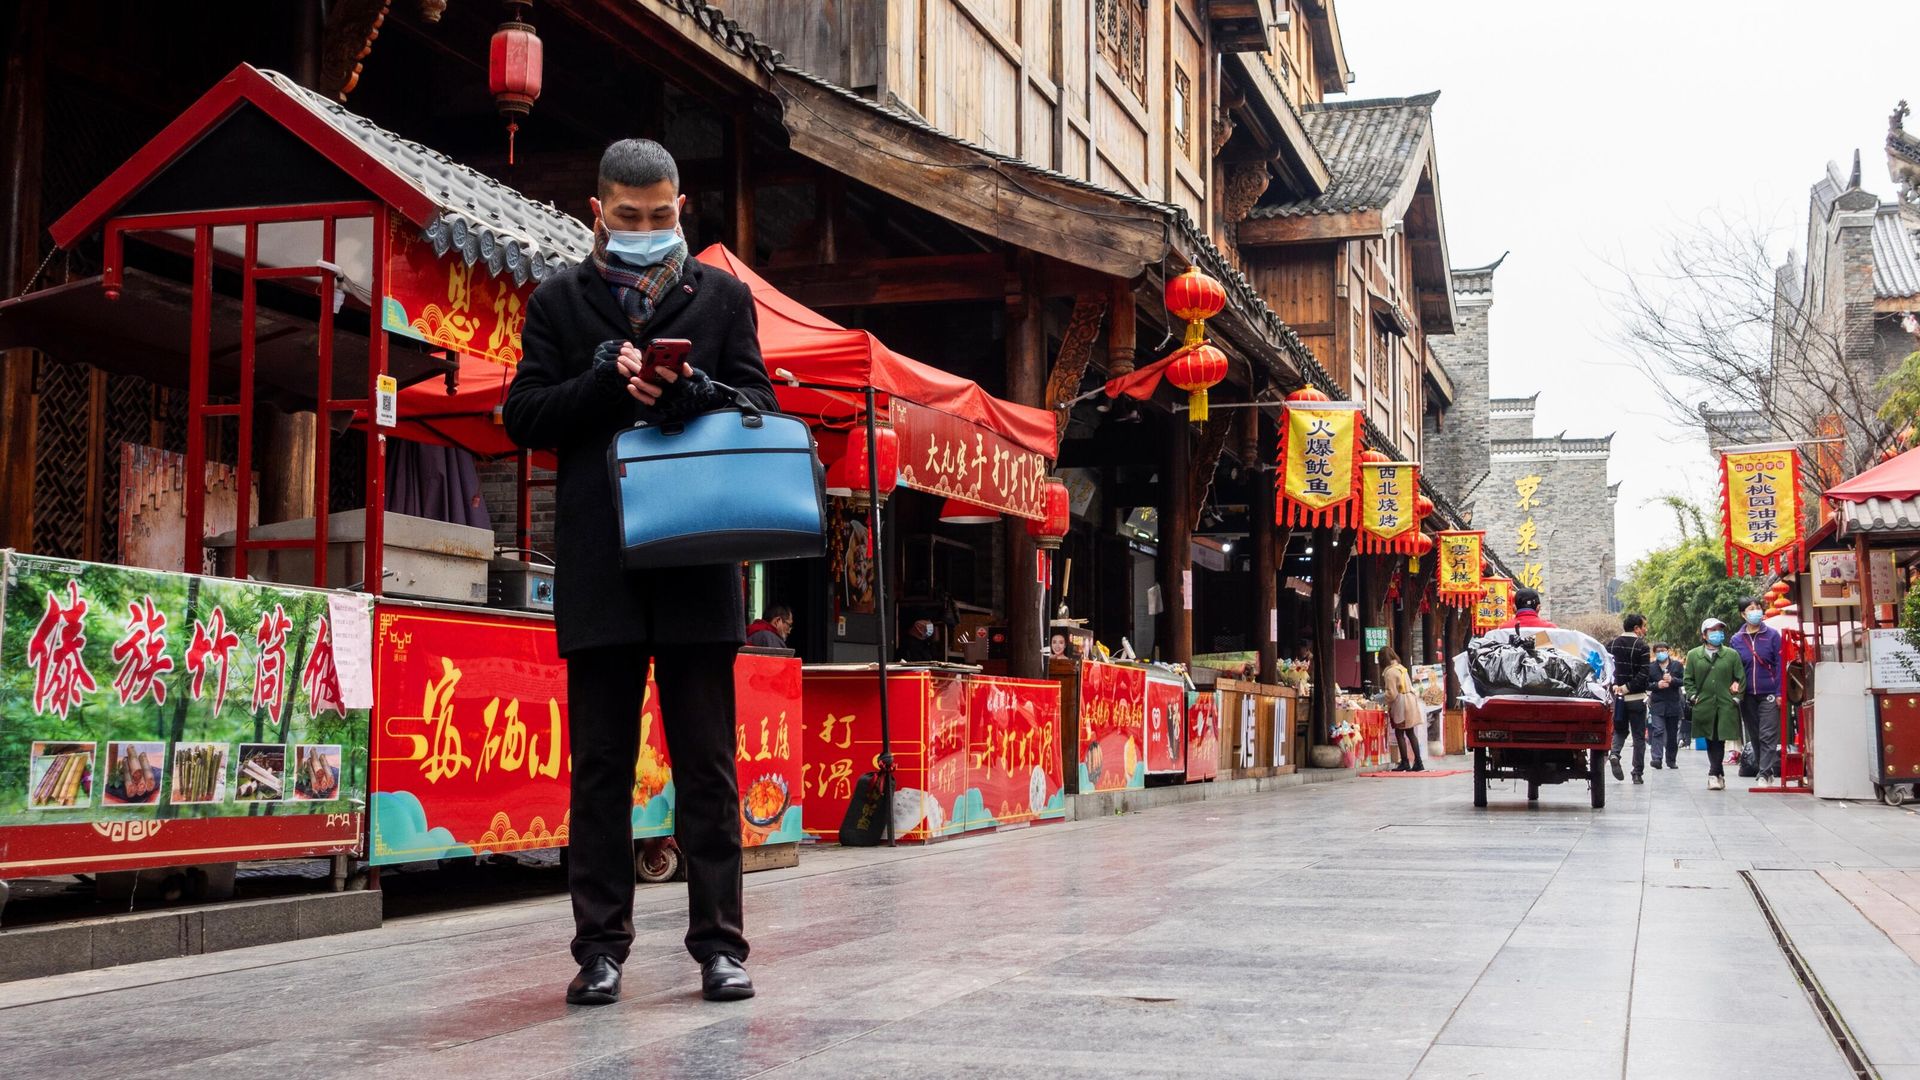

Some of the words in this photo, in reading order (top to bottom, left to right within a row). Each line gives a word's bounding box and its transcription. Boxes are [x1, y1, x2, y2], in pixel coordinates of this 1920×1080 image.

[1303, 419, 1336, 496] 火爆鱿鱼
[1376, 465, 1399, 528] 西北烧烤
[1744, 472, 1779, 543] 小桃园油酥饼
[801, 713, 857, 749] 打
